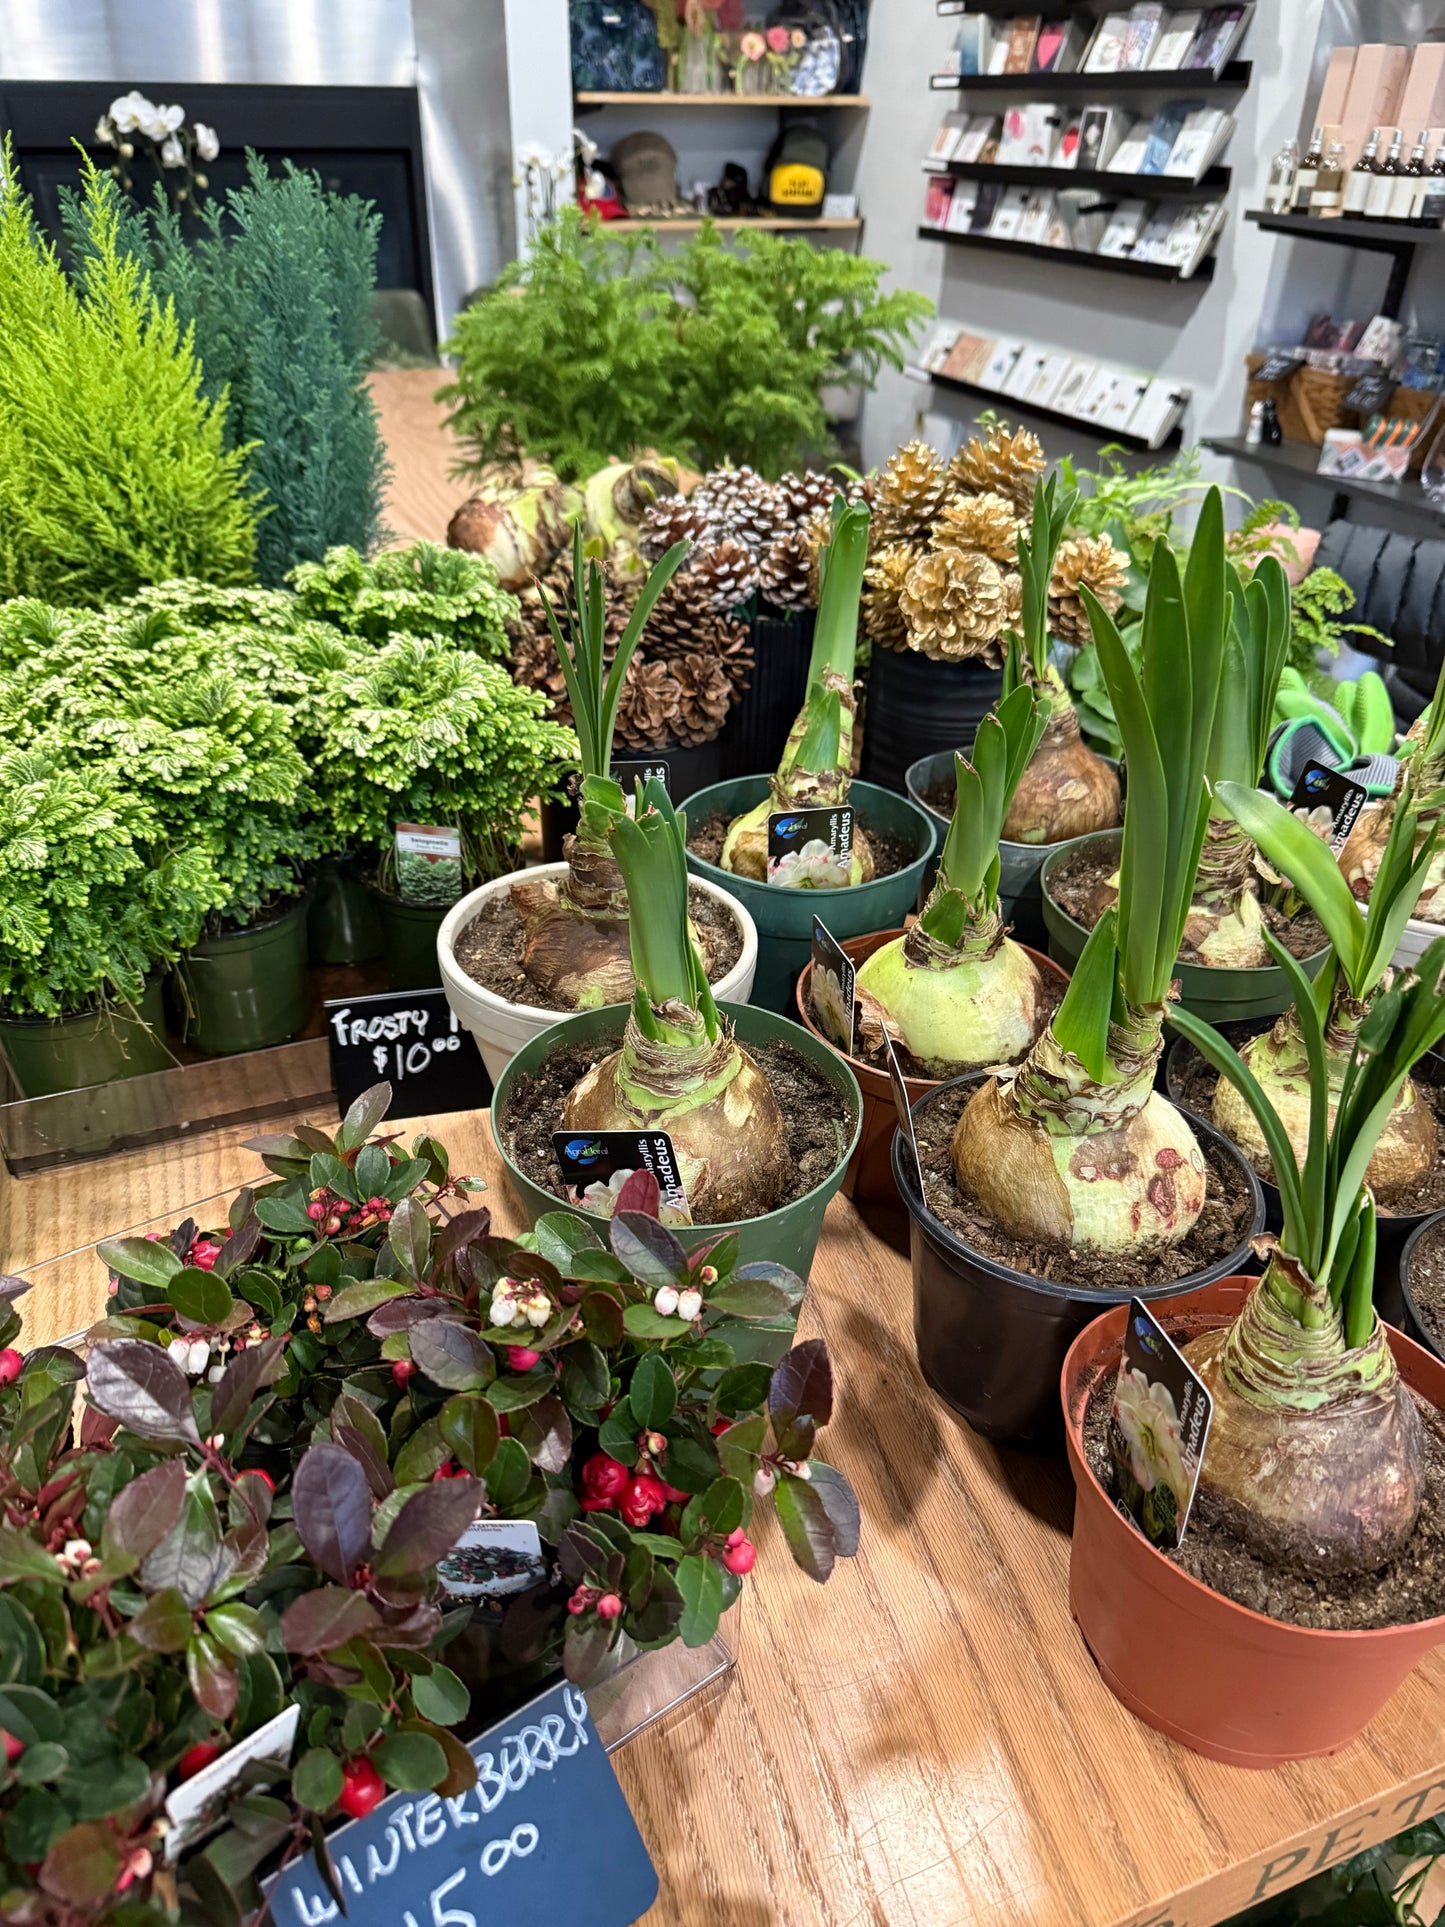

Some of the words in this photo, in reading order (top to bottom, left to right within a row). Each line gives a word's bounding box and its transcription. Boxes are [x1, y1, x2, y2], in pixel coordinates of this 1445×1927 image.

[829, 813, 838, 850] Amaryllis
[1329, 793, 1364, 852] Amadeus
[1332, 788, 1355, 829] Amaryllis
[837, 811, 851, 868] Amadeus
[844, 968, 853, 1024] Amadeus
[330, 1008, 430, 1046] FROSTY
[638, 1139, 654, 1175] maryllis
[653, 1138, 682, 1209] Amadeus
[1177, 1378, 1194, 1434] Amaryllis
[1181, 1392, 1207, 1474] Amadeus
[291, 1687, 589, 1927] WINTERBERRY
[1245, 1780, 1445, 1906] PET
